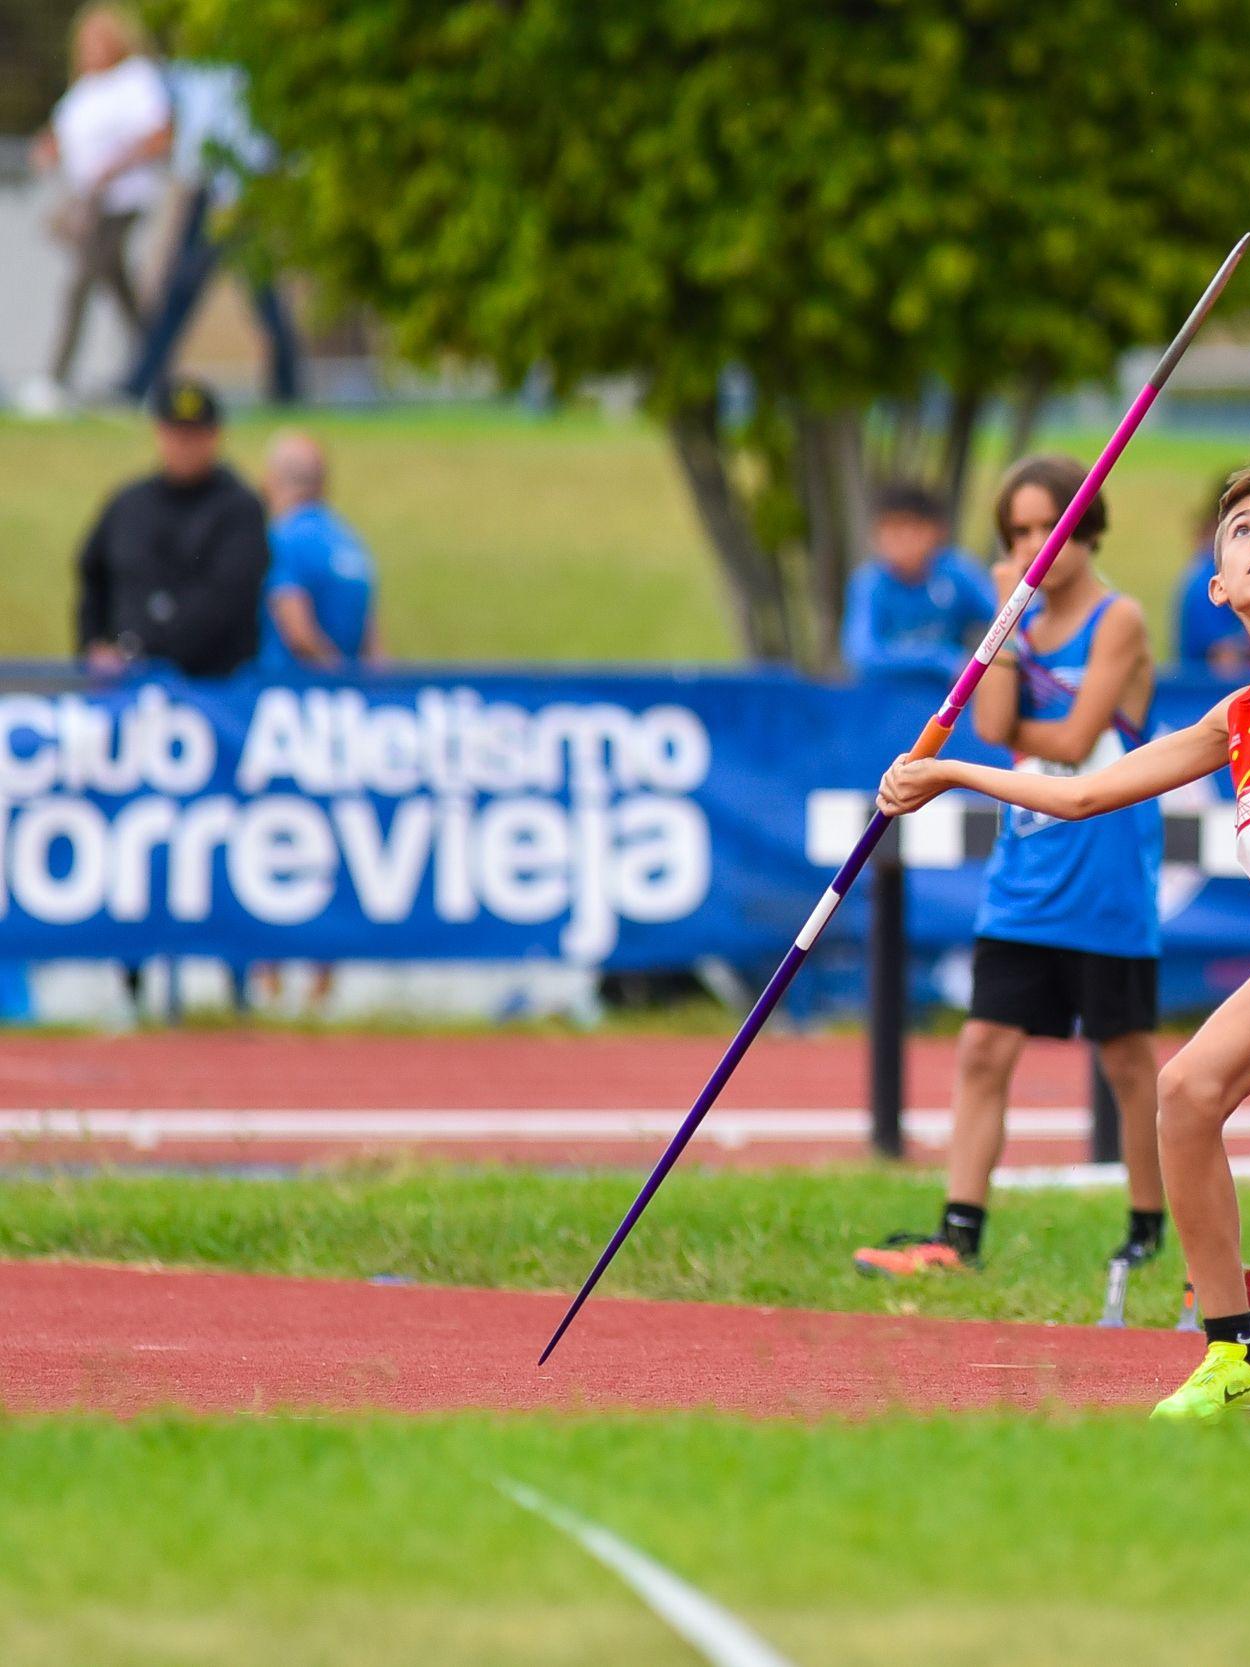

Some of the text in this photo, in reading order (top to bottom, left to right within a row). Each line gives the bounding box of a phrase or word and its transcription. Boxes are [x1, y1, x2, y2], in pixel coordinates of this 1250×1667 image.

[0, 684, 712, 798] Club Atletismo
[0, 792, 712, 962] orrevieja
